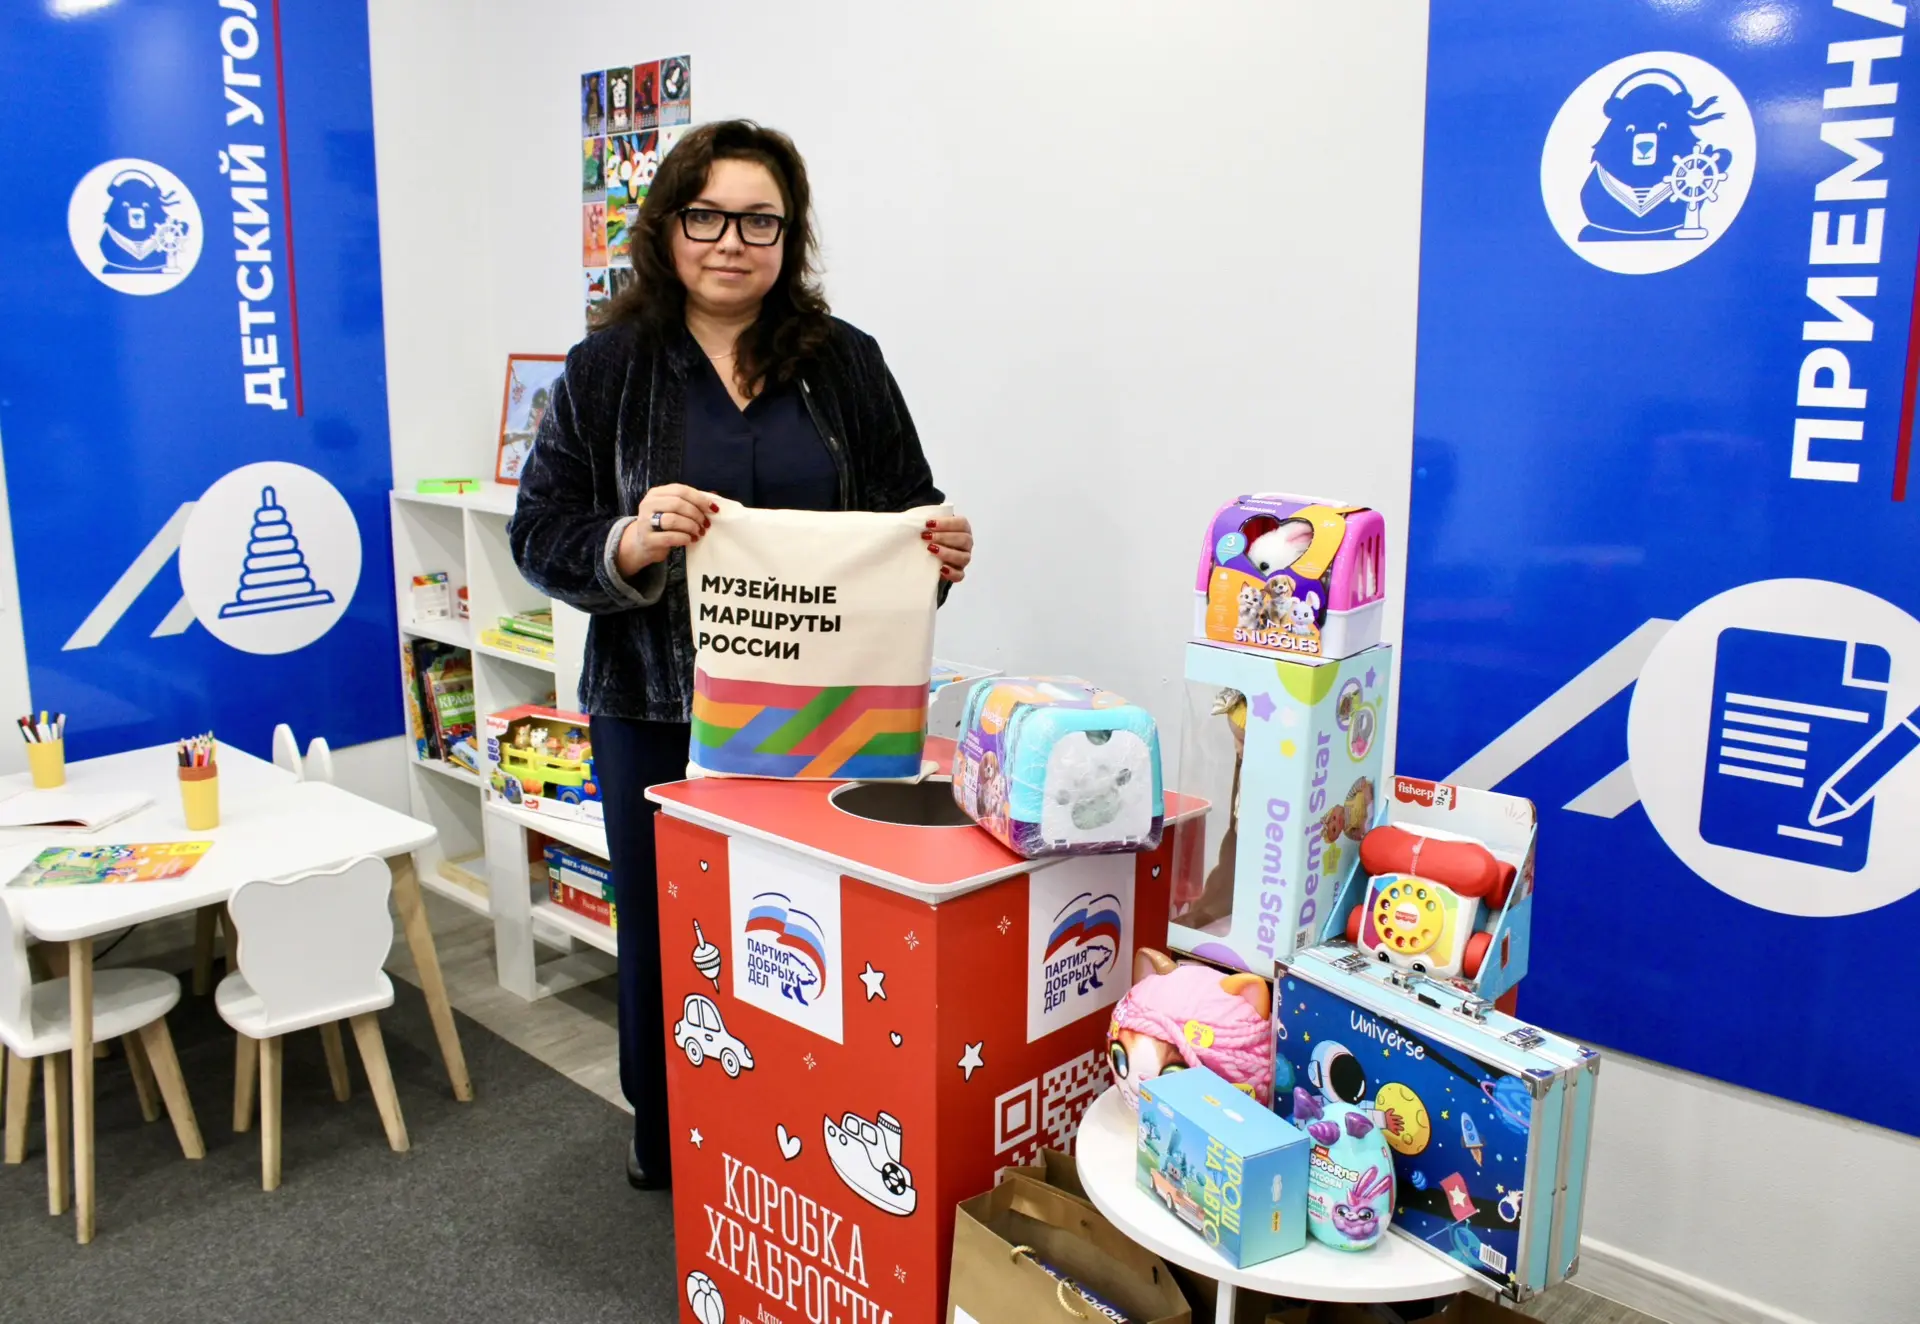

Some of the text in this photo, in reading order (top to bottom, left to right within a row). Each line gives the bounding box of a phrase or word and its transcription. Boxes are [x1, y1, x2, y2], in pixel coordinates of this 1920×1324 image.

[219, 143, 289, 411] ДЕТСКИЙ
[1226, 534, 1236, 547] 3
[701, 574, 837, 604] МУЗЕЙНЫЕ
[700, 603, 841, 632] МАРШРУТЫ
[699, 631, 800, 660] РОССИИ
[1233, 627, 1320, 654] SNUGGLES
[1308, 730, 1331, 815] Star
[1256, 797, 1291, 960] Demi Star
[1299, 822, 1323, 927] Demi
[747, 938, 790, 966] ПАРТИЯ
[1045, 949, 1087, 979] ПАРТИЯ
[747, 954, 796, 984] ДОБРЫХ
[748, 969, 769, 988] ДЕЛ
[1044, 962, 1092, 998] ДОБРЫХ
[1043, 990, 1066, 1014] ДЕЛ
[1350, 1009, 1425, 1061] Universe
[1203, 1135, 1225, 1248] НА АВТО
[1221, 1148, 1243, 1235] КРОШ
[722, 1152, 869, 1288] КОРОБКА
